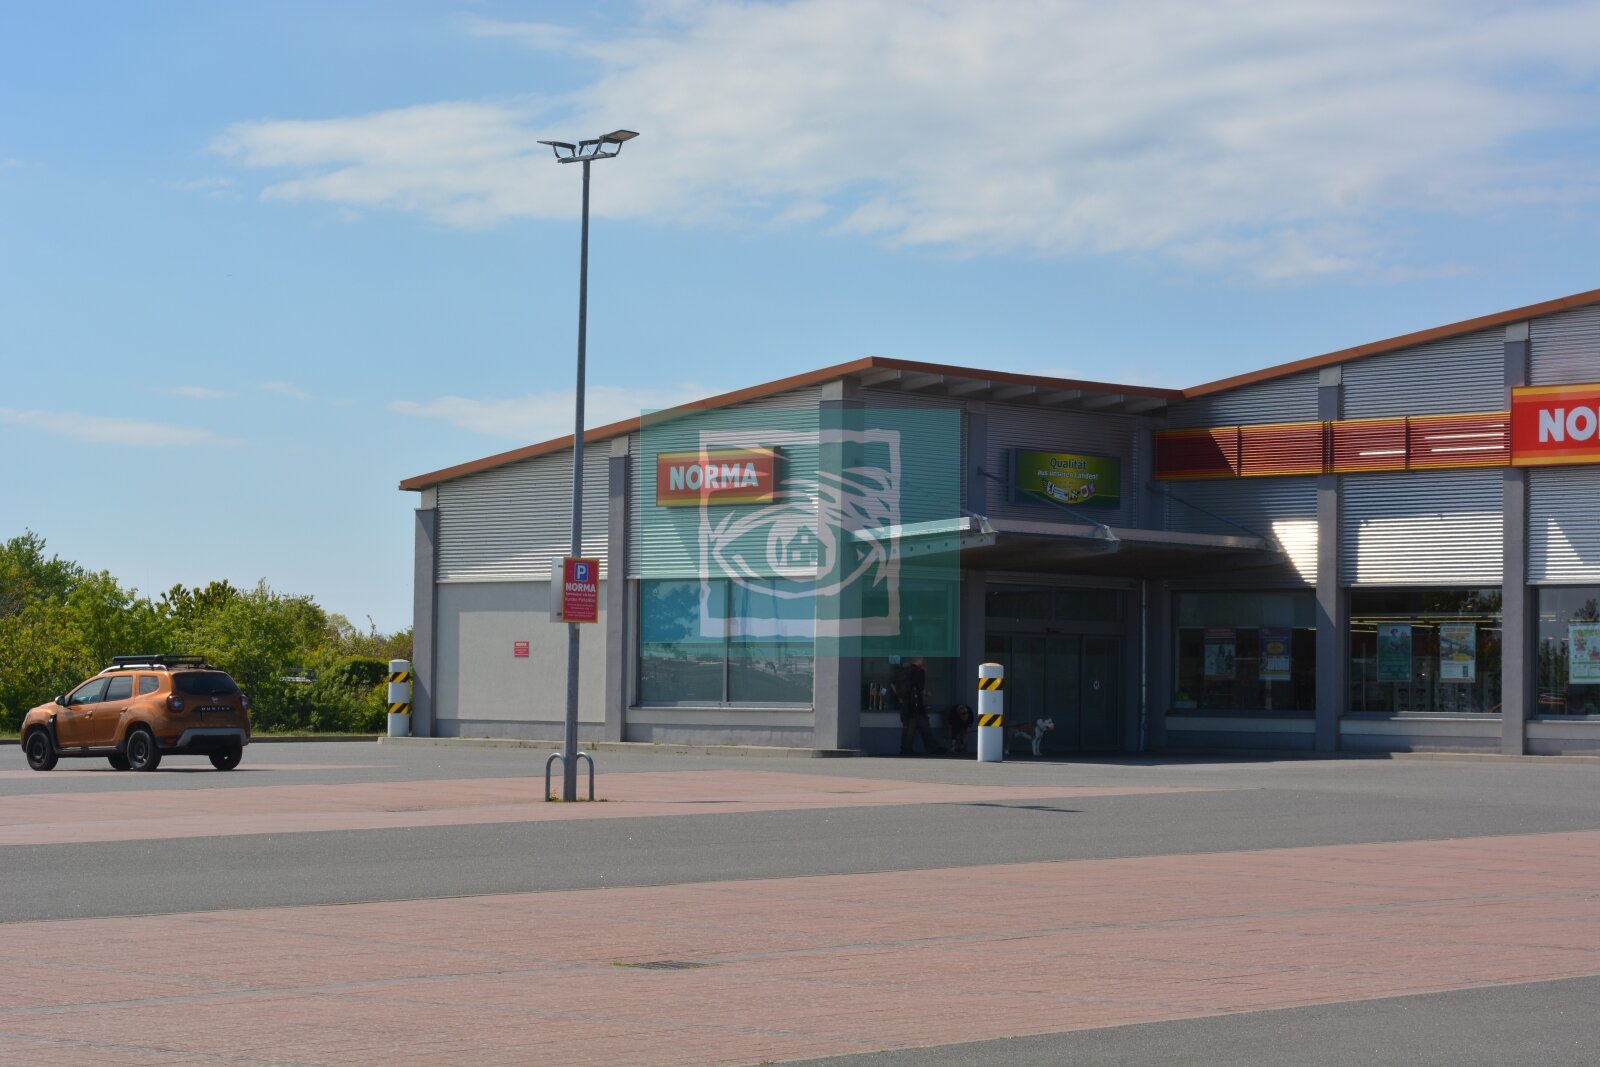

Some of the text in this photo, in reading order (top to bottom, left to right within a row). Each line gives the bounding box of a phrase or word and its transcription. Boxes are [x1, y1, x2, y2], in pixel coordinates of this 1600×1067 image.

[1538, 406, 1600, 443] NO
[1050, 457, 1088, 470] Qualität
[669, 462, 759, 491] NORMA
[577, 565, 586, 580] P
[565, 582, 596, 593] NORMA
